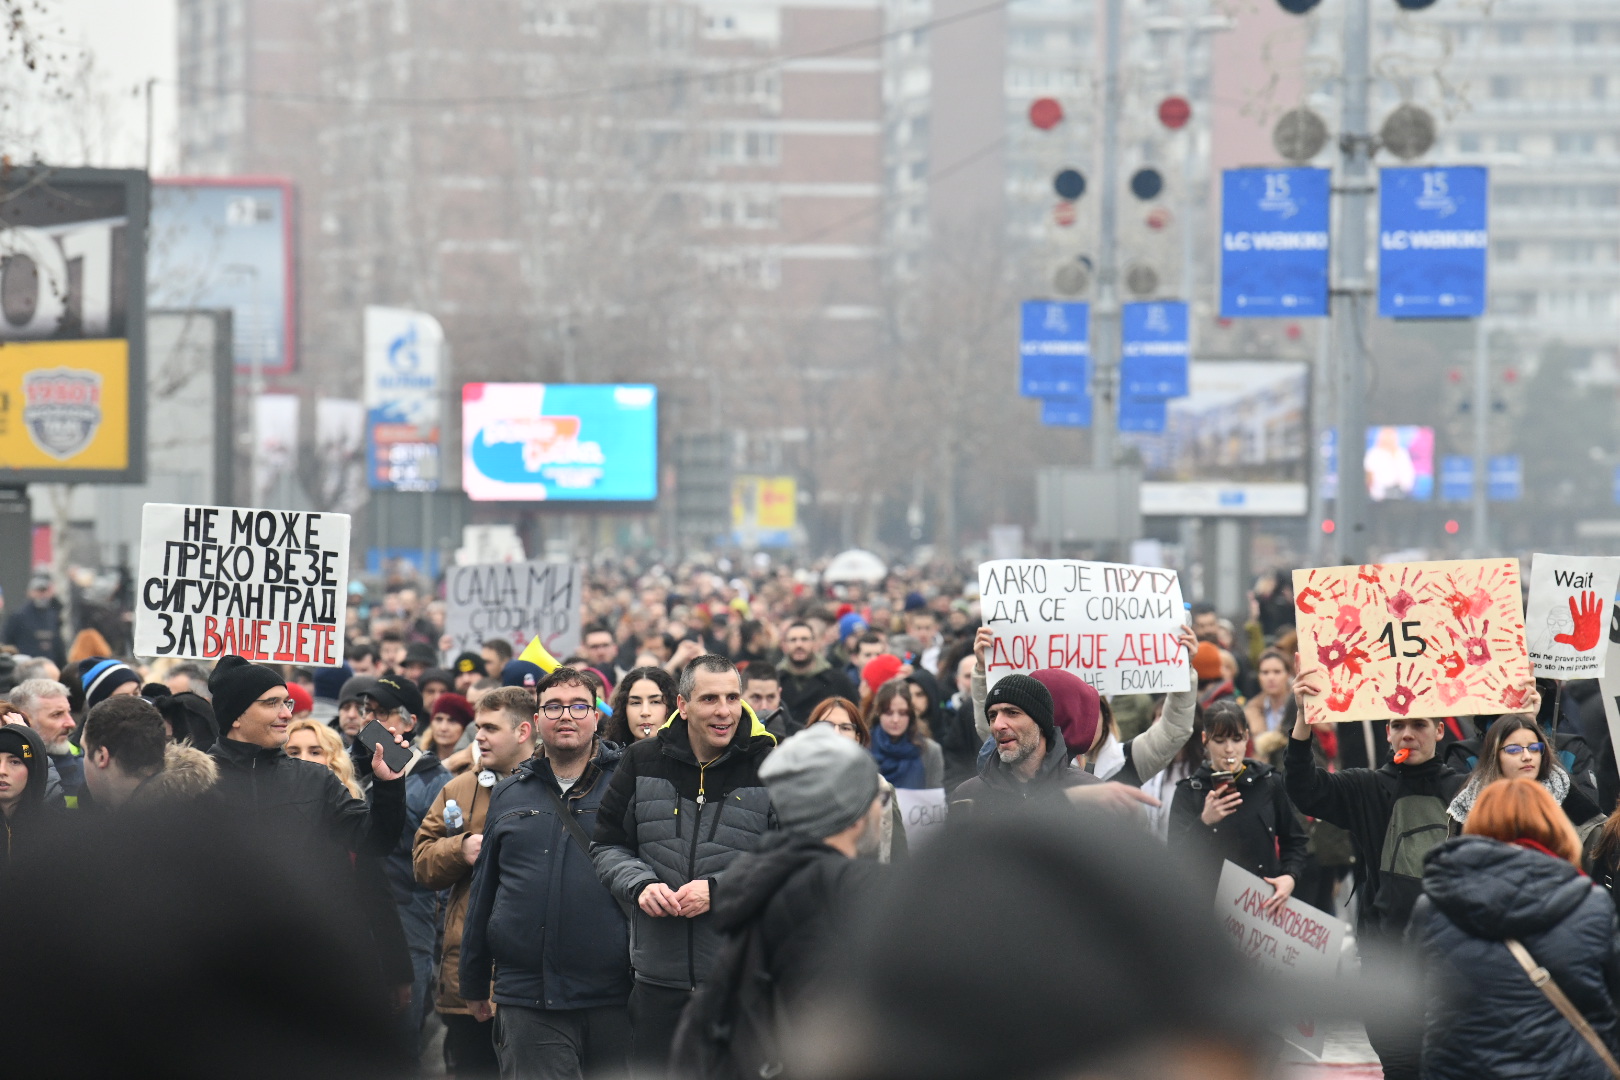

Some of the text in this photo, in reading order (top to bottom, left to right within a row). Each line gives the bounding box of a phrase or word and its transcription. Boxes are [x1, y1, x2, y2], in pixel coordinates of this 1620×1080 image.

[183, 507, 322, 550] НЕ МОЖЕ
[163, 540, 339, 586] ПРЕКО ВЕЗЕ
[983, 564, 1176, 595] ЛАКО ЈЕ ПРУТУ
[1554, 569, 1594, 589] Wait
[452, 565, 574, 609] САДА МИ
[987, 596, 1173, 625] ДА СЕ СОКОЛИ
[156, 613, 336, 665] ЗА ВАШЕ ДЕТЕ
[988, 633, 1183, 671] ДОК БИЈЕ ДЕЦУ,
[1378, 621, 1427, 658] 15
[1084, 672, 1105, 691] НЕ
[1575, 663, 1599, 671] pravimo
[1234, 887, 1265, 921] ЛАЖ
